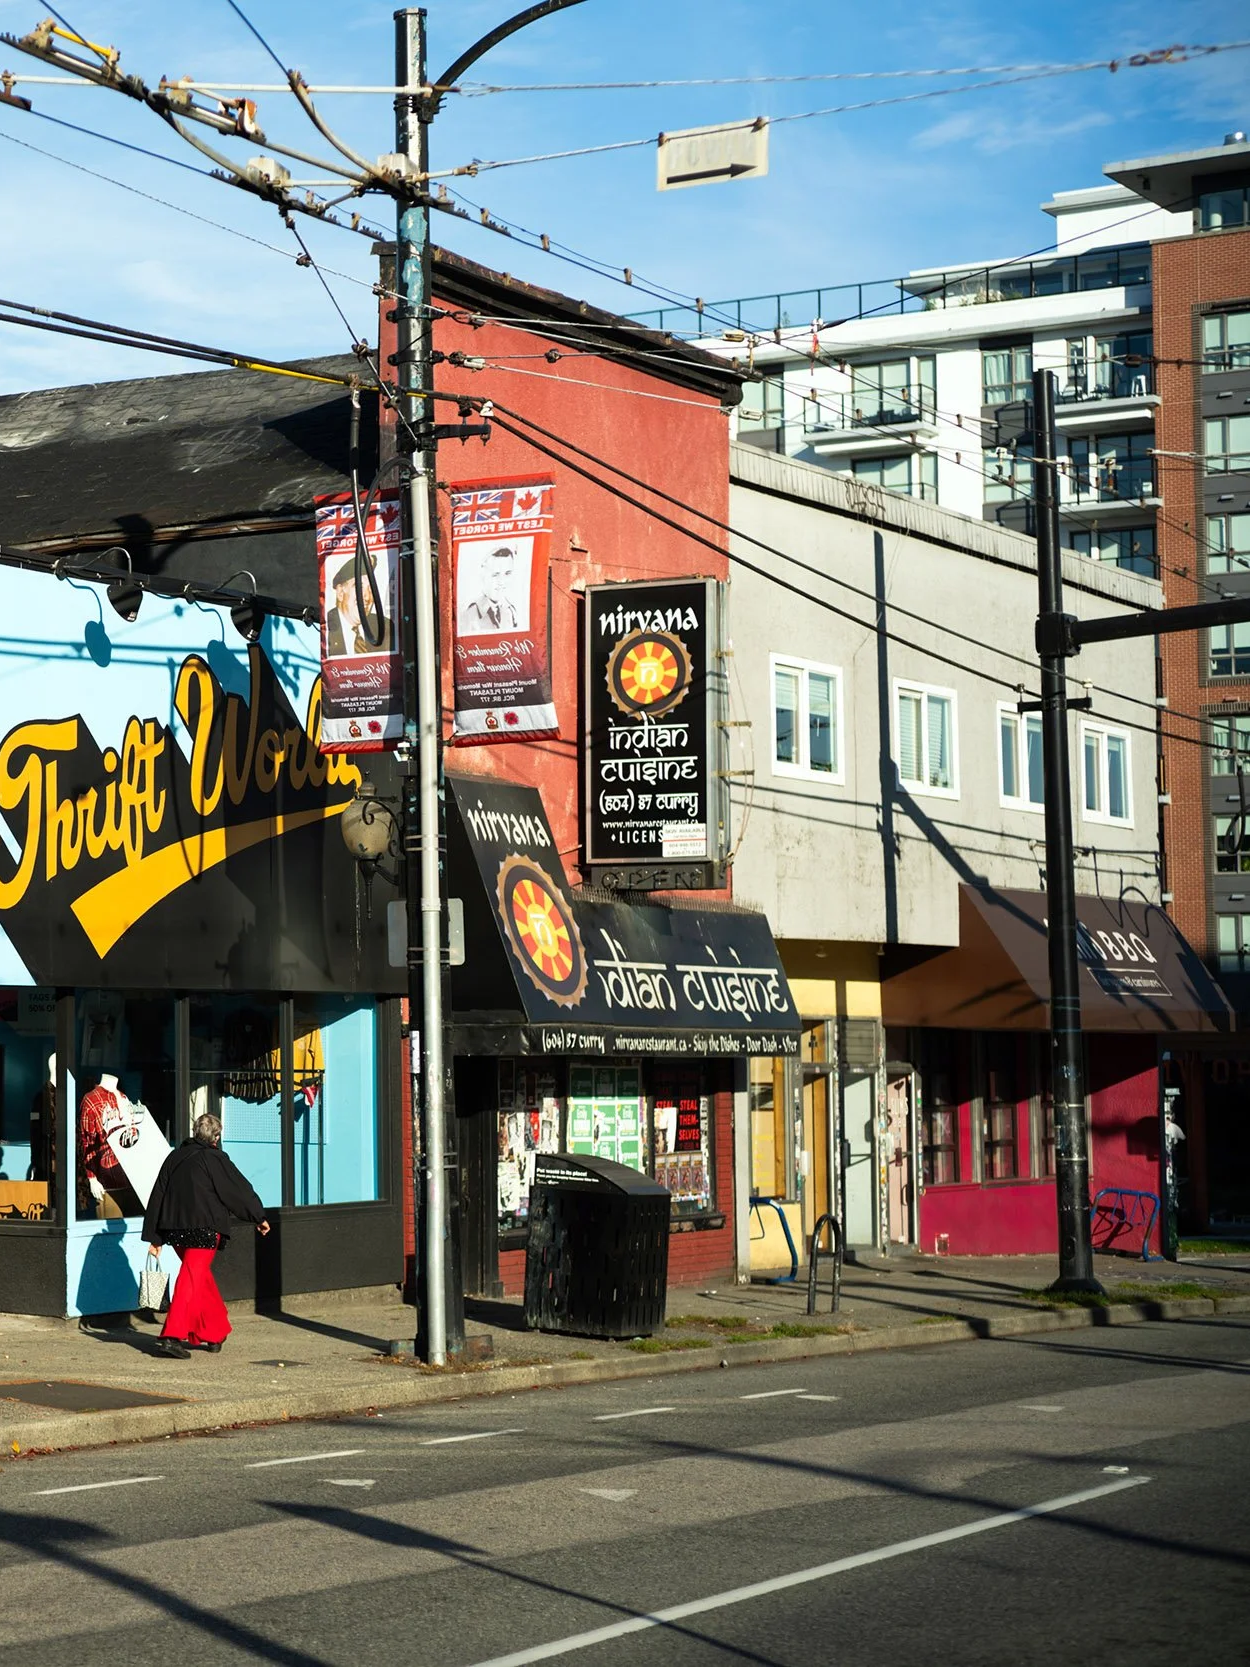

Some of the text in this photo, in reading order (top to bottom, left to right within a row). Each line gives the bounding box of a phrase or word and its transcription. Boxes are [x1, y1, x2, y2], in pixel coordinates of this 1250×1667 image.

[599, 604, 699, 636] nirvana
[608, 711, 690, 750] indian
[600, 749, 699, 785] cuisine
[599, 788, 699, 817] (604) 87 curry
[467, 799, 551, 848] nirvana
[602, 818, 699, 829] www.nirvanarestaurantca
[619, 830, 664, 844] LICENS
[1096, 930, 1158, 964] BBQ
[593, 928, 789, 1022] dian cuisine
[542, 1028, 564, 1053] (604)
[579, 1034, 605, 1054] curry
[720, 1034, 740, 1052] Dishes
[746, 1036, 761, 1052] Door
[762, 1034, 778, 1052] Dash
[680, 1100, 698, 1110] STEAL
[678, 1128, 700, 1140] SELVES
[679, 1114, 699, 1126] THEM-
